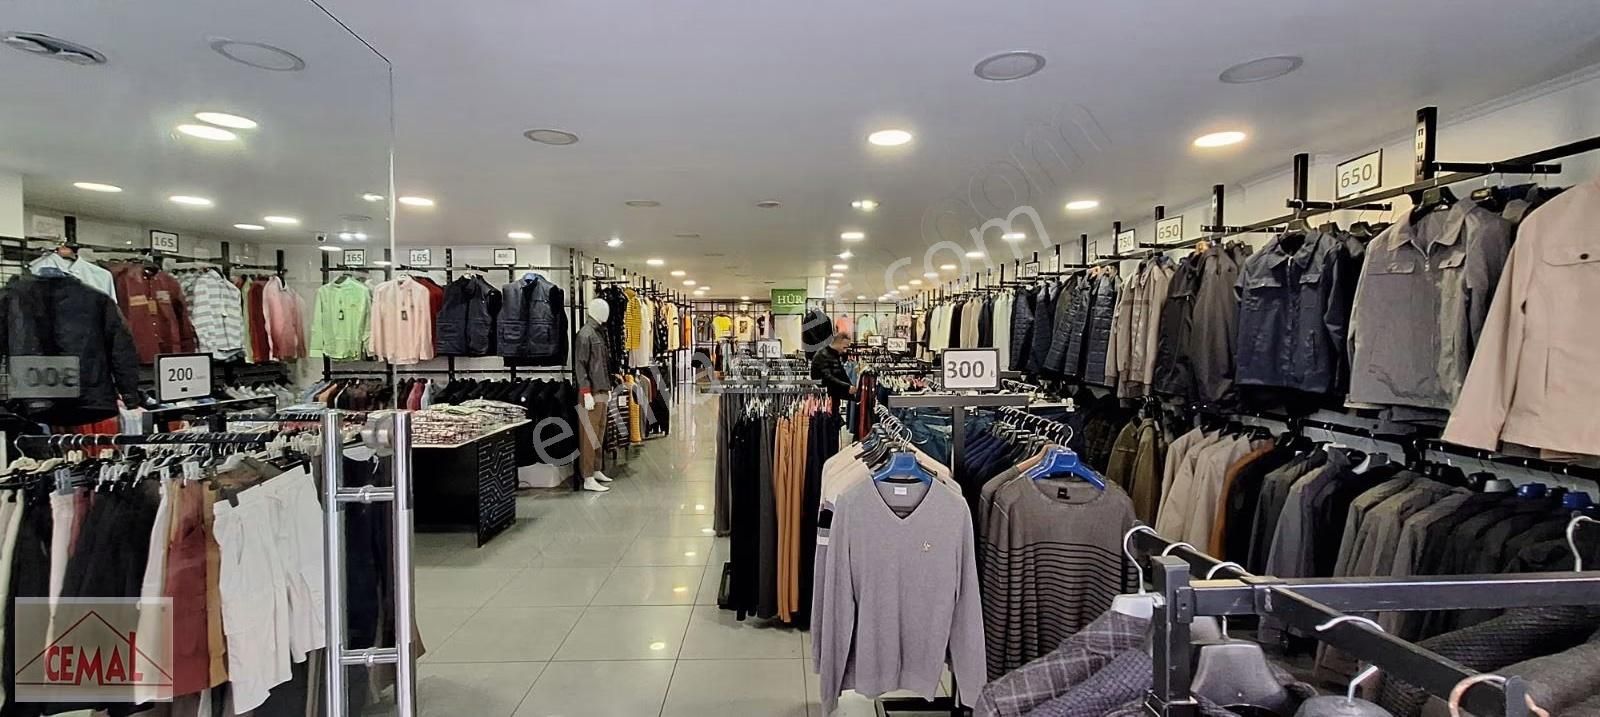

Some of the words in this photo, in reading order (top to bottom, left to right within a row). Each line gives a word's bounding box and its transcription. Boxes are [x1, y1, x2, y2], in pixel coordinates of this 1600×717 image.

[1340, 163, 1372, 188] 650
[1159, 224, 1179, 238] 650
[154, 236, 173, 248] 165
[1119, 234, 1132, 249] 750
[346, 253, 362, 262] 165
[411, 253, 428, 262] 165
[168, 367, 193, 382] 200
[946, 360, 985, 379] 300
